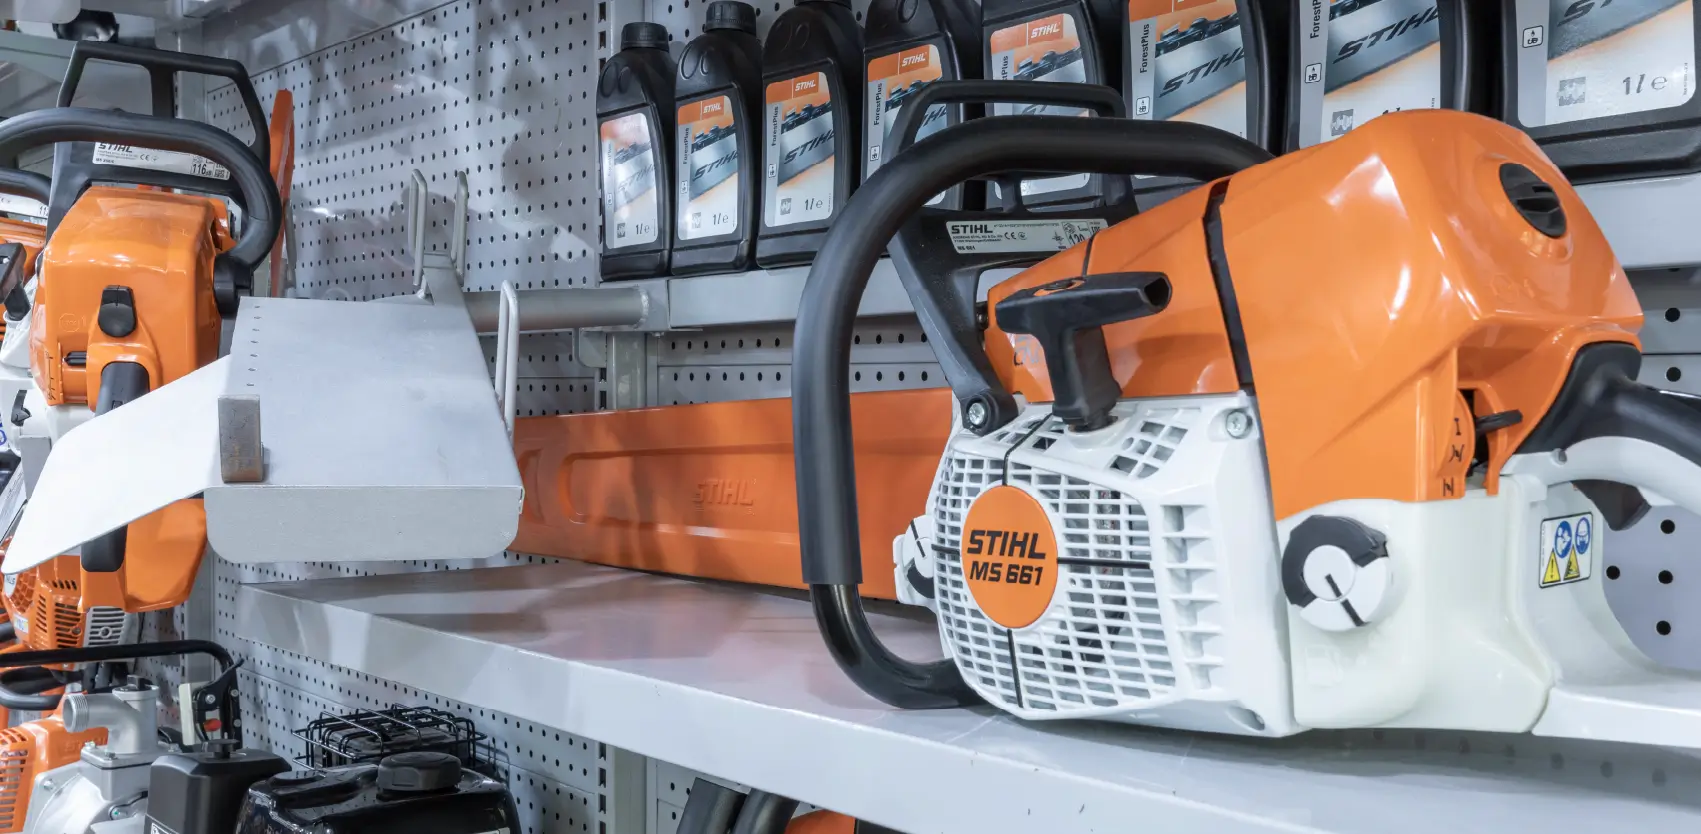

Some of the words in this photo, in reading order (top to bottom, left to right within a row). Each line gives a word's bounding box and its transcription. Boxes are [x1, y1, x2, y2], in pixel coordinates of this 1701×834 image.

[1031, 22, 1060, 38] STIHL
[1310, 0, 1321, 39] ForestP
[1139, 23, 1150, 74] ForestPlus
[1332, 6, 1439, 64] STIHL
[901, 52, 926, 67] STIHL
[1158, 46, 1245, 98] STIHL
[795, 79, 816, 92] STIHL
[703, 102, 722, 114] STIHL
[873, 83, 883, 126] ForestPlus
[771, 106, 779, 147] ForestPlus
[784, 129, 835, 165] STIHL
[192, 164, 206, 175] 116
[693, 150, 738, 180] STIHL
[951, 224, 993, 234] STIHL
[693, 479, 754, 506] STIHL
[967, 530, 1047, 559] STIHL
[970, 561, 1003, 582] MS
[1006, 563, 1043, 586] 661
